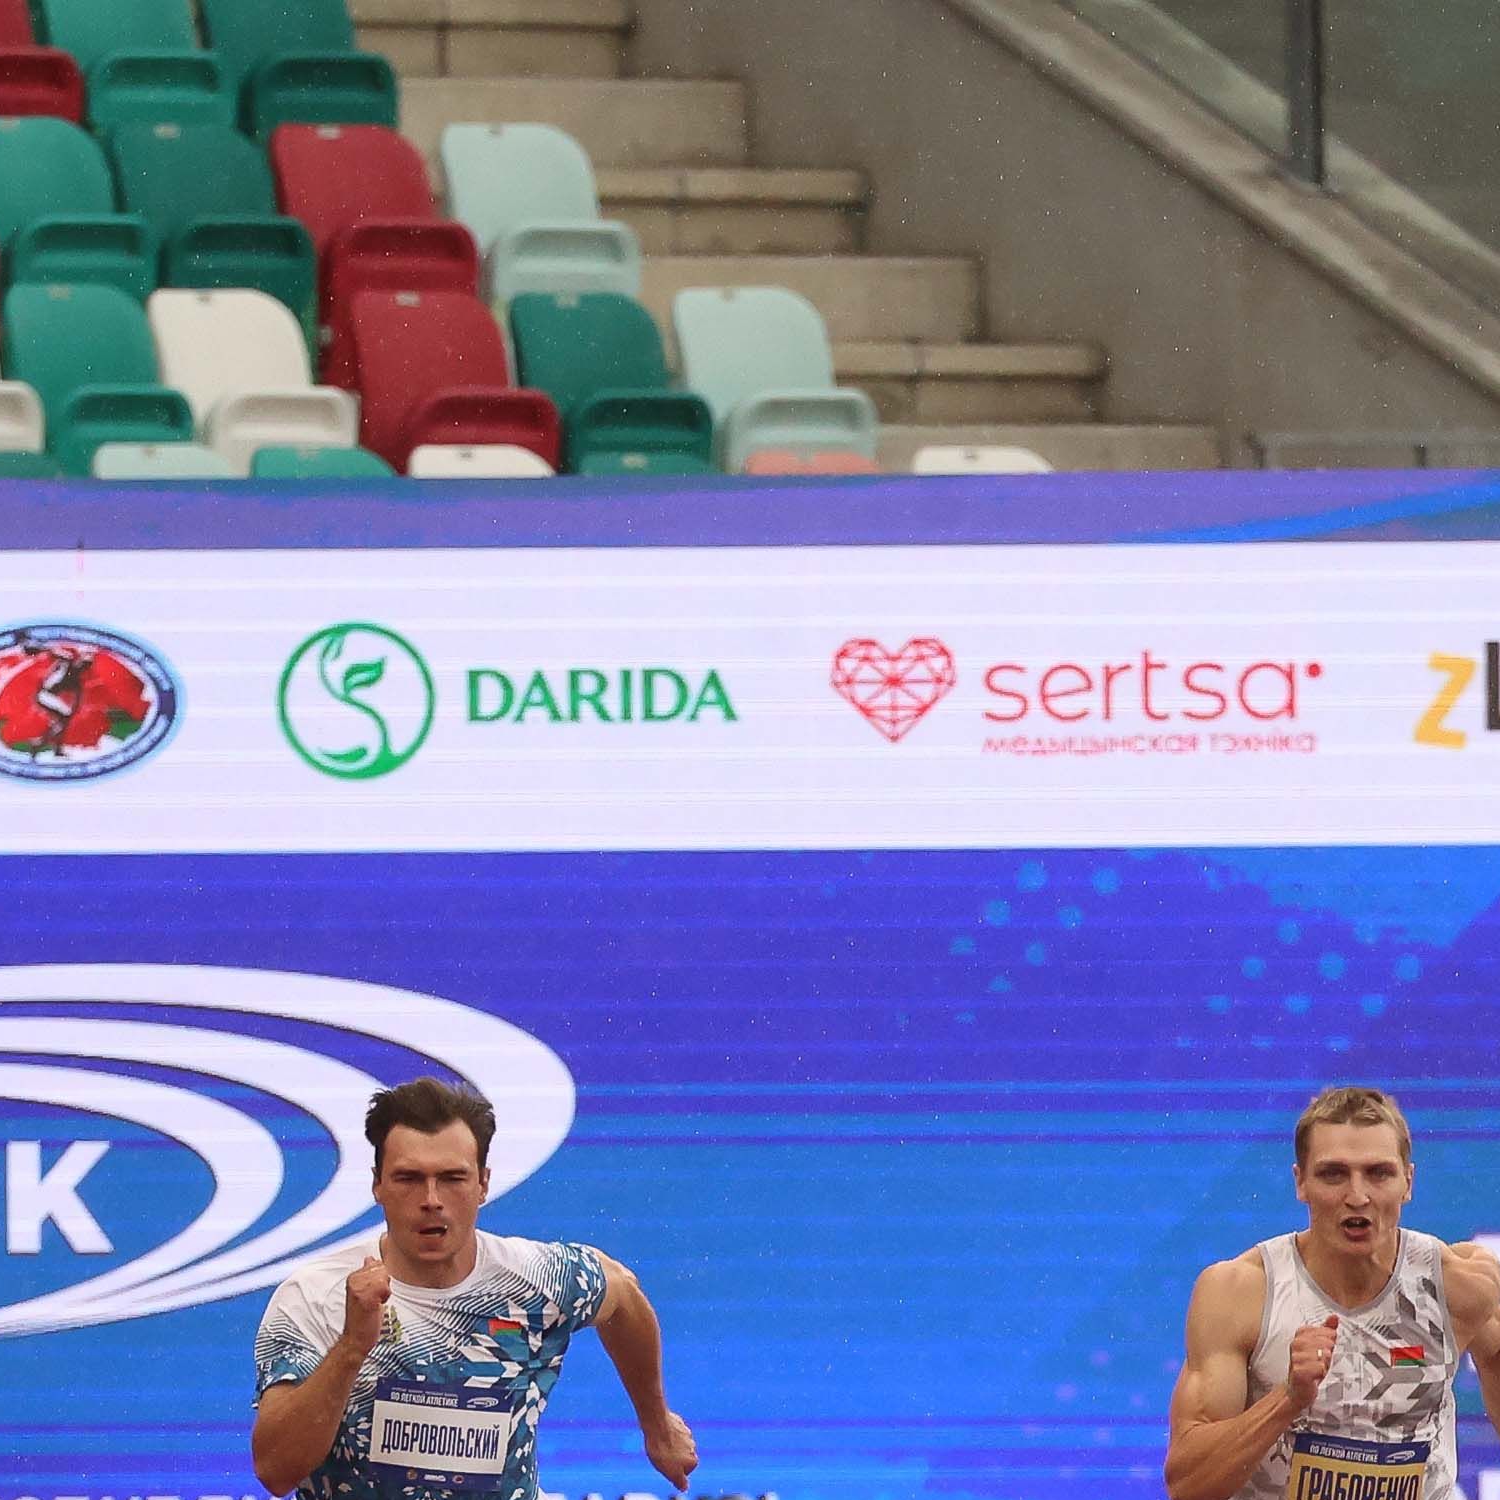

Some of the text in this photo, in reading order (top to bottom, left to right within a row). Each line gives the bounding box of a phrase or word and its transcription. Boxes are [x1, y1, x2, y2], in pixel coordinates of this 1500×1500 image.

[466, 669, 738, 723] DARIDA
[983, 649, 1297, 721] sertsa
[381, 1418, 500, 1460] ДОБРОВОЛЬСКИЙ
